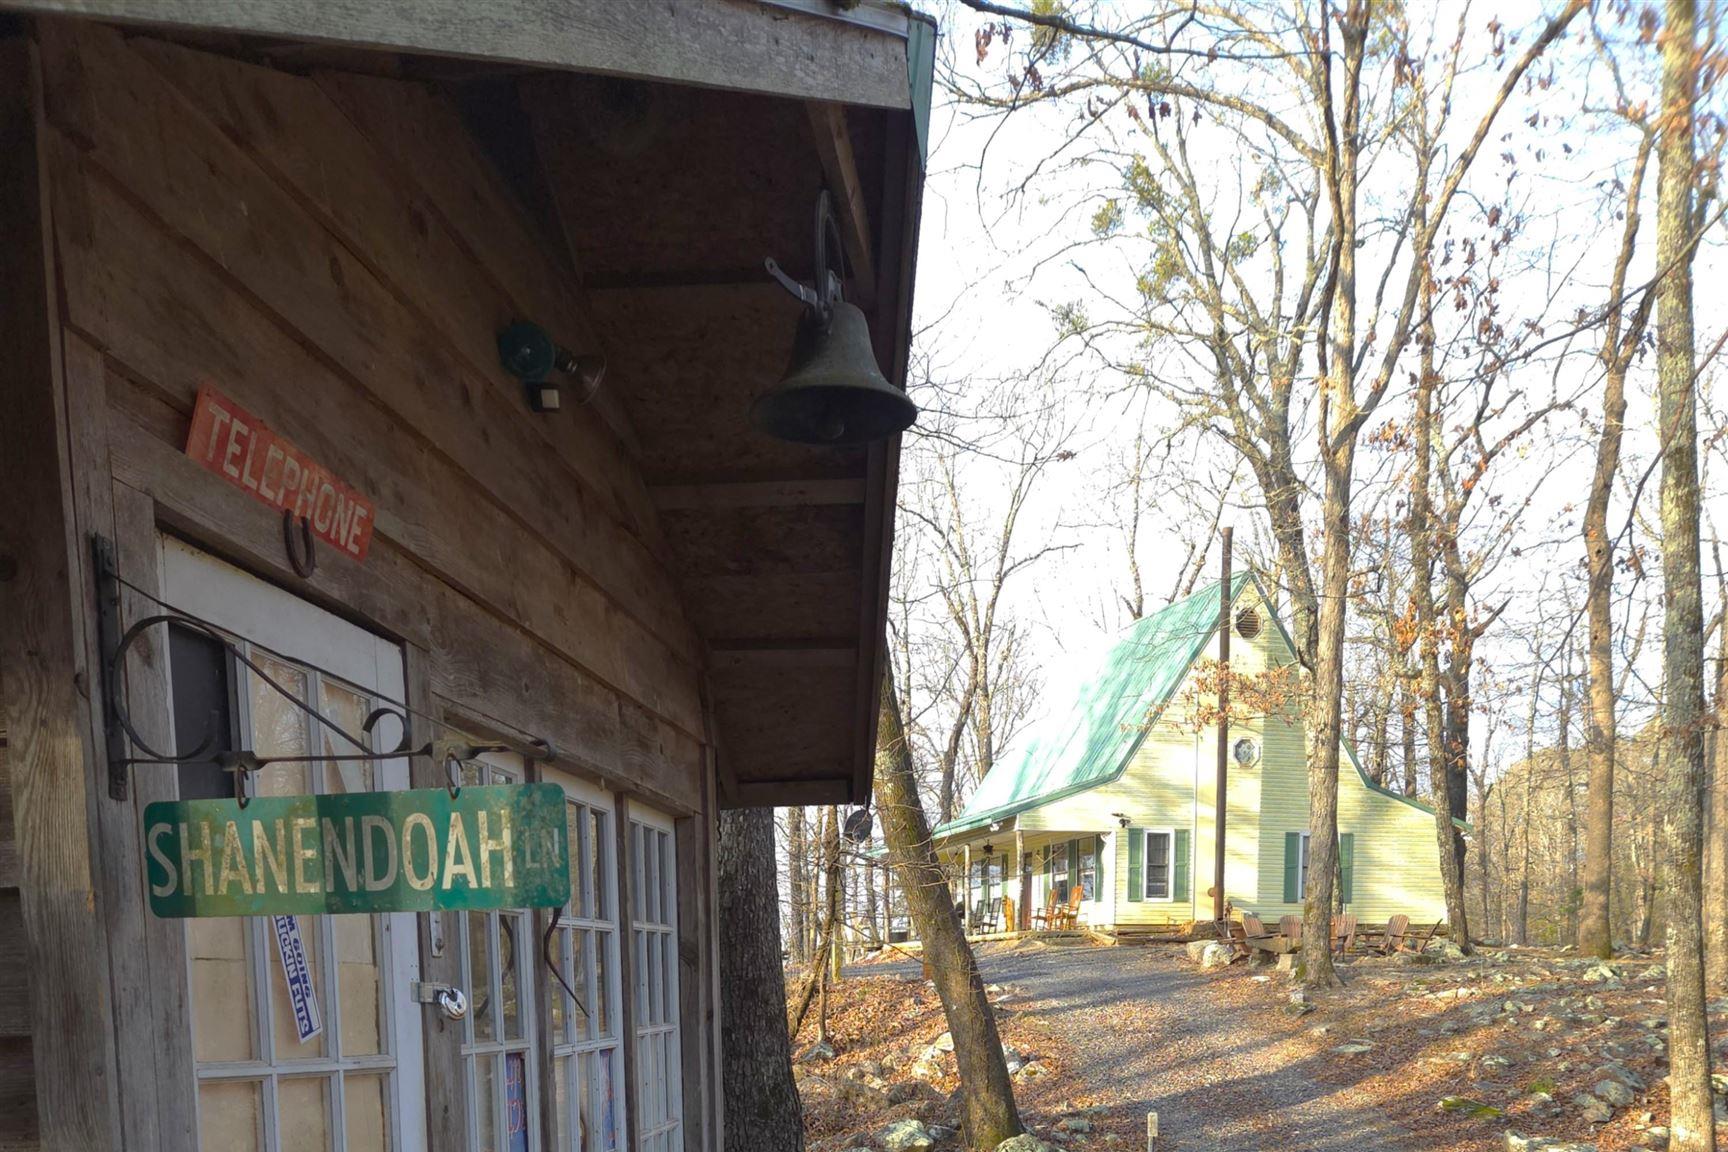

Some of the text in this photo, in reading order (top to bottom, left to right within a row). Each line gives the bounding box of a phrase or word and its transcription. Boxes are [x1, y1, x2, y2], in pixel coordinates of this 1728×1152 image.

[148, 810, 559, 898] SHANENDOAH LN
[293, 938, 311, 998] GOING
